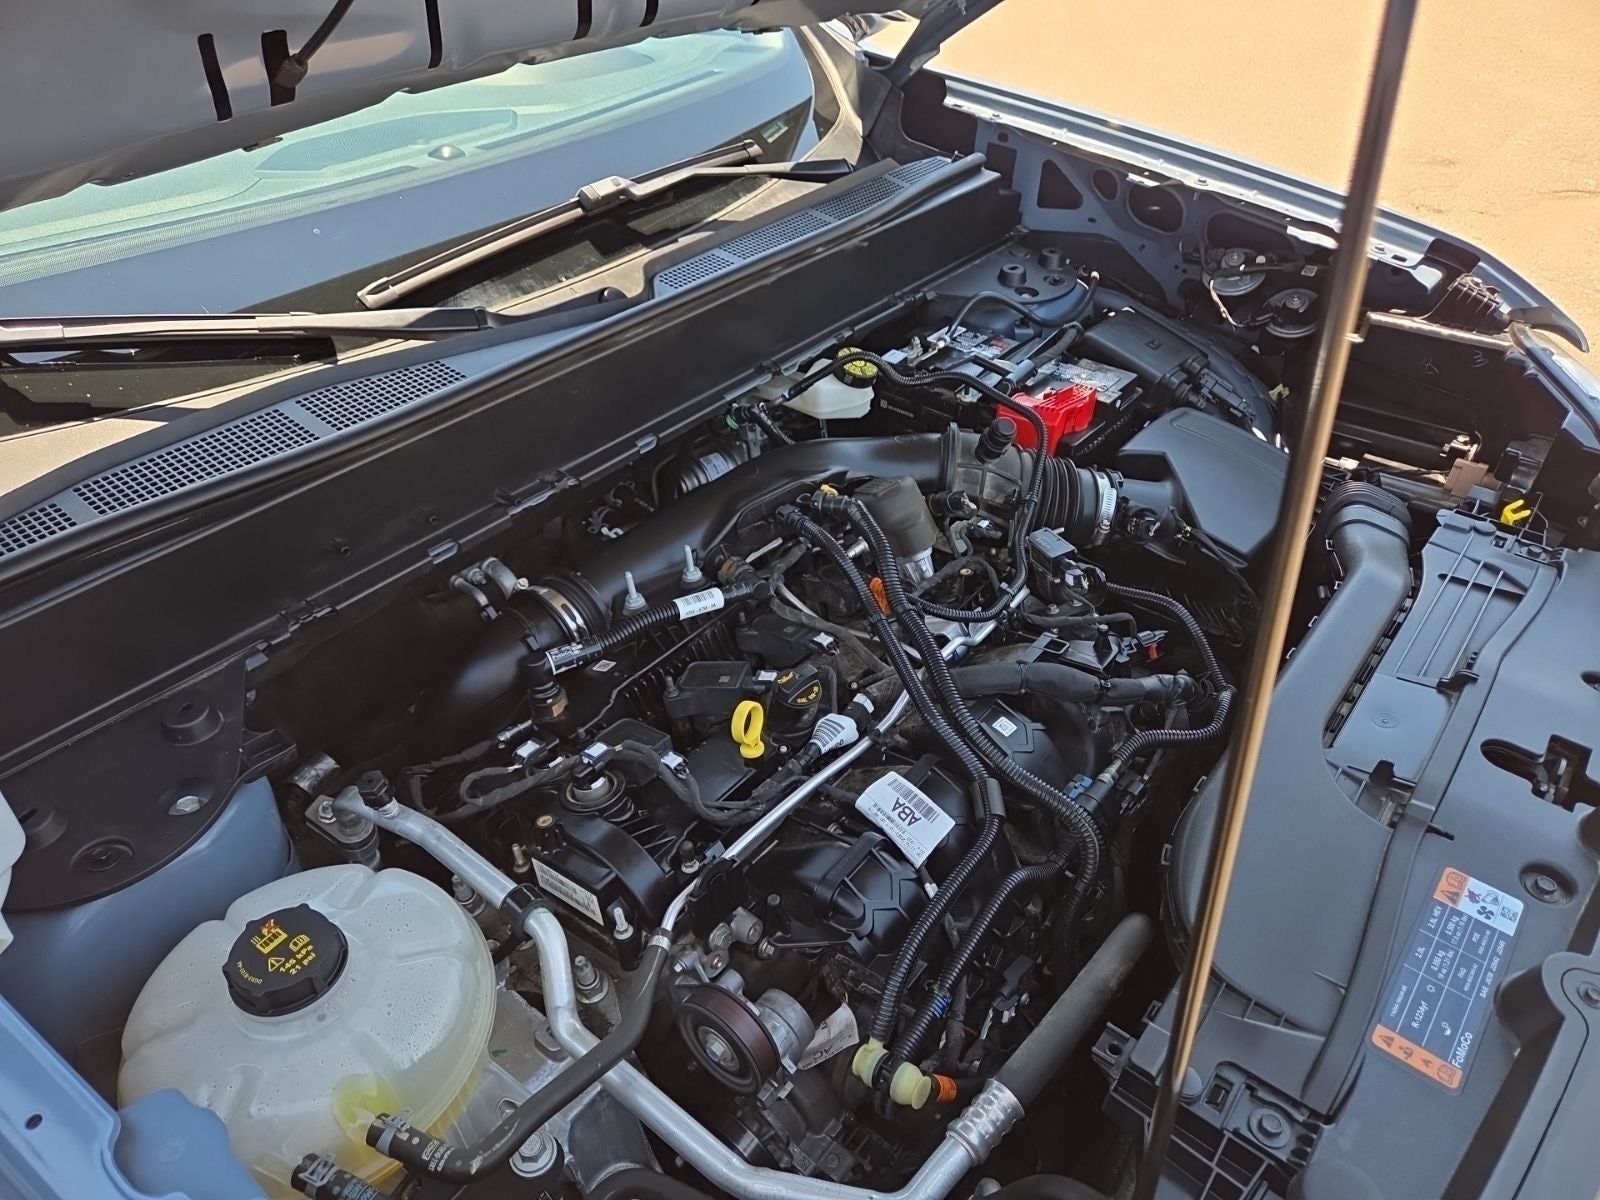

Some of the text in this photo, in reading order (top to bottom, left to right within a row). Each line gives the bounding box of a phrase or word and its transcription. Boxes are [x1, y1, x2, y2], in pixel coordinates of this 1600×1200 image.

[892, 797, 921, 827] ABA
[289, 952, 316, 976] 21 psi
[296, 945, 313, 959] kPa
[1479, 985, 1489, 998] SAE
[1411, 1000, 1428, 1029] R-1234yf
[1451, 1031, 1473, 1068] FoMoCo
